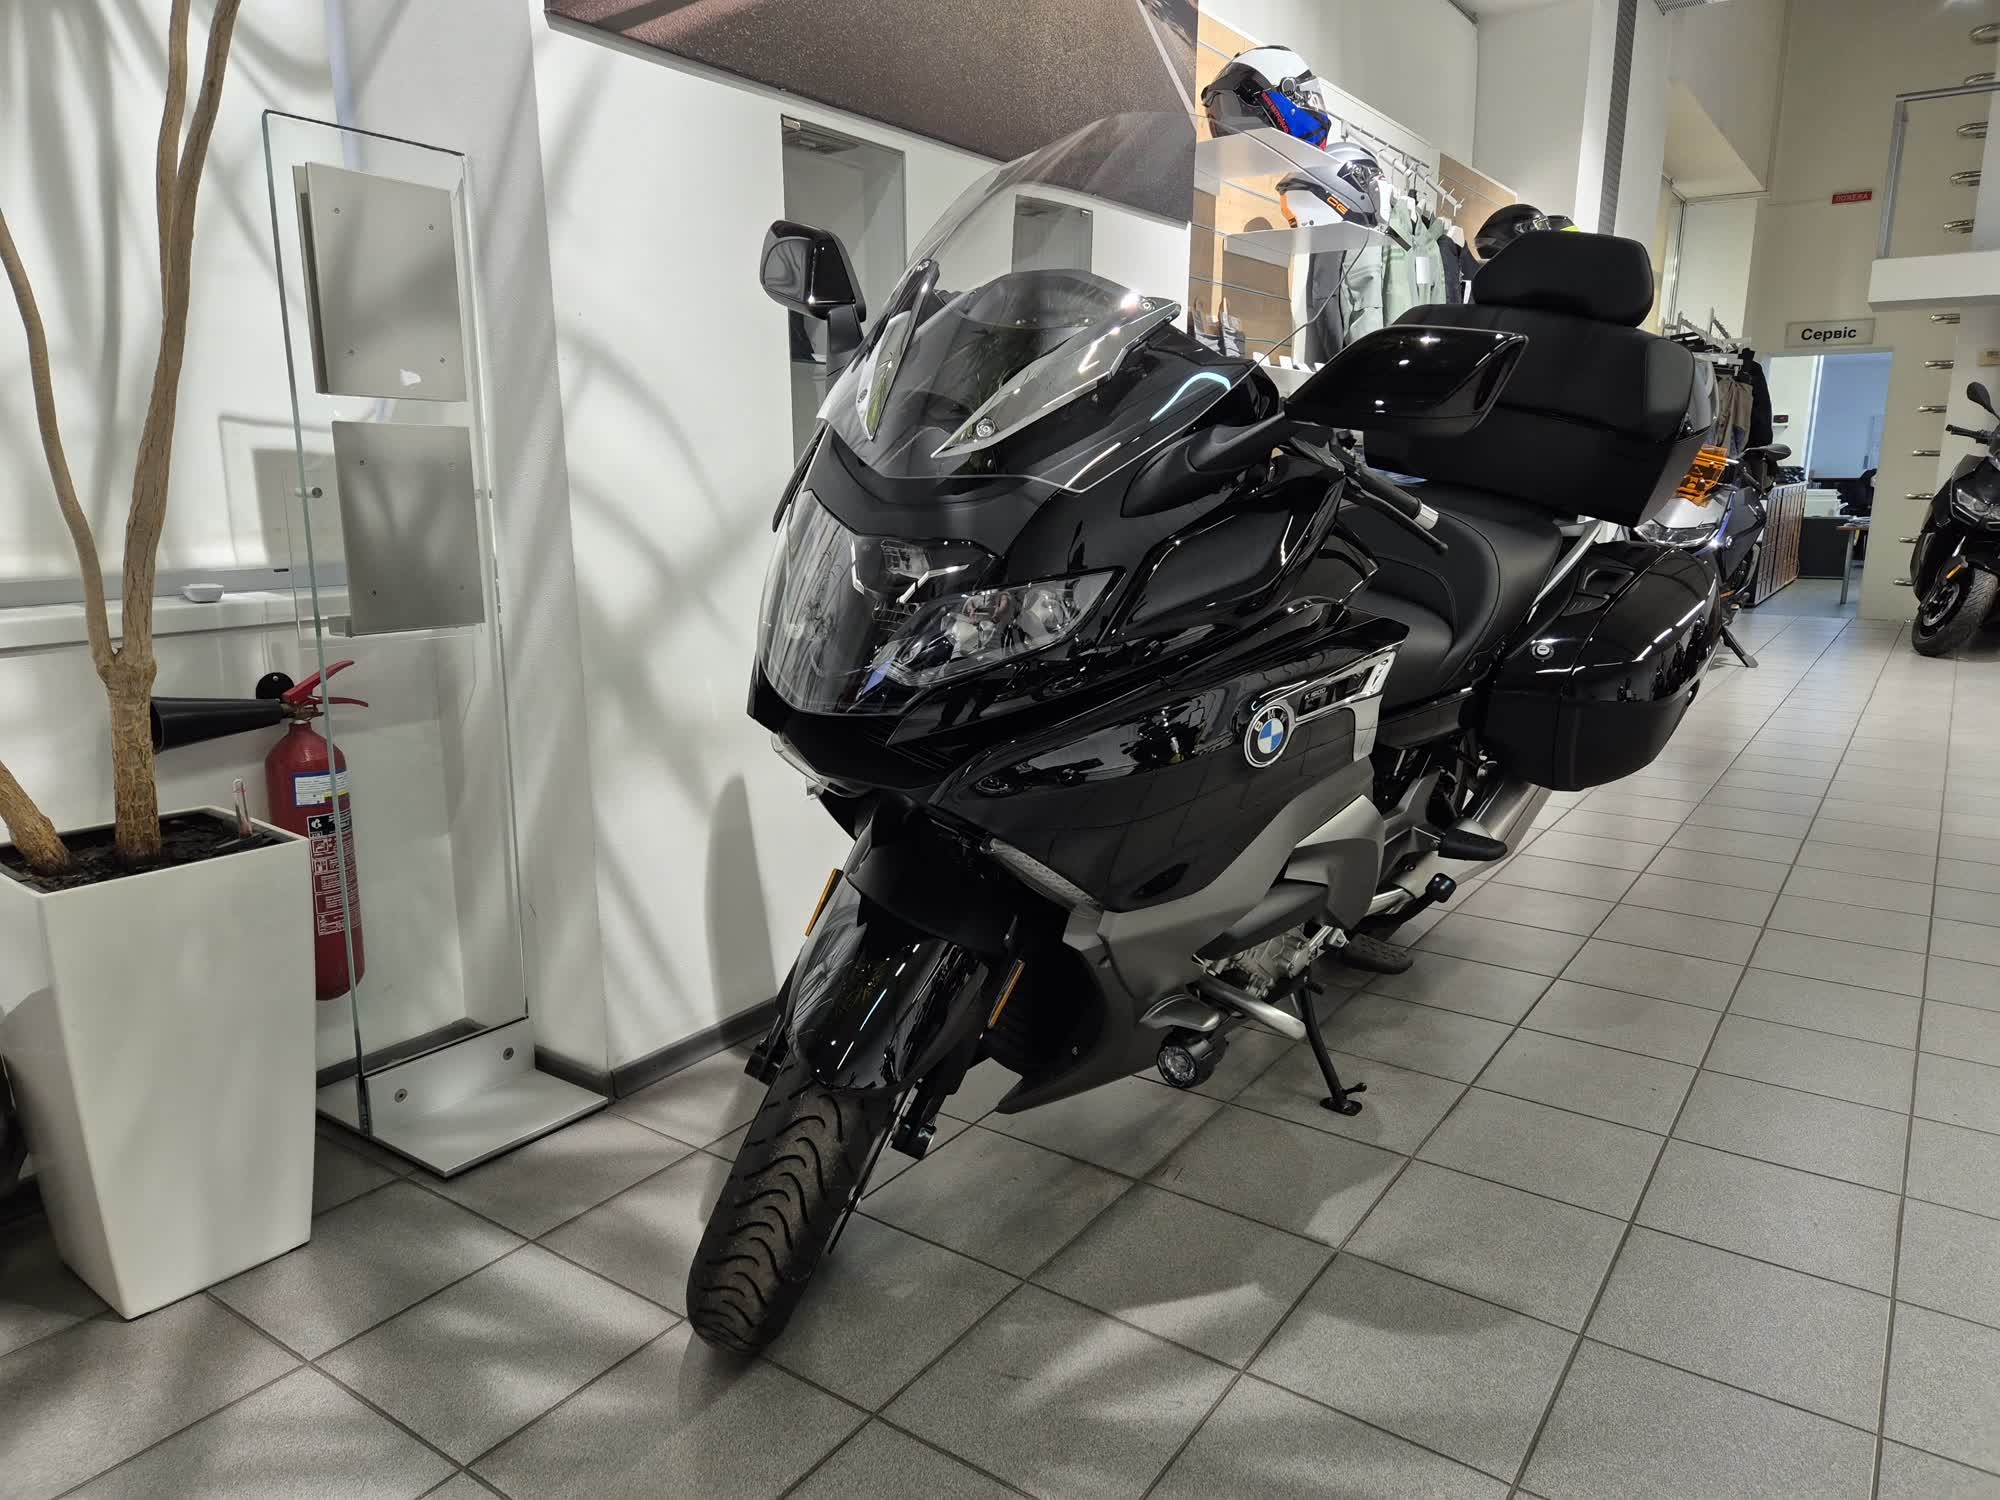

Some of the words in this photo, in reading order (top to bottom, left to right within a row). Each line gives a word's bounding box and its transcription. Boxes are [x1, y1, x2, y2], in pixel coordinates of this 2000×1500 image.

[1801, 326, 1857, 343] Сервіс
[1310, 687, 1327, 697] 1600
[1254, 708, 1288, 732] BMW
